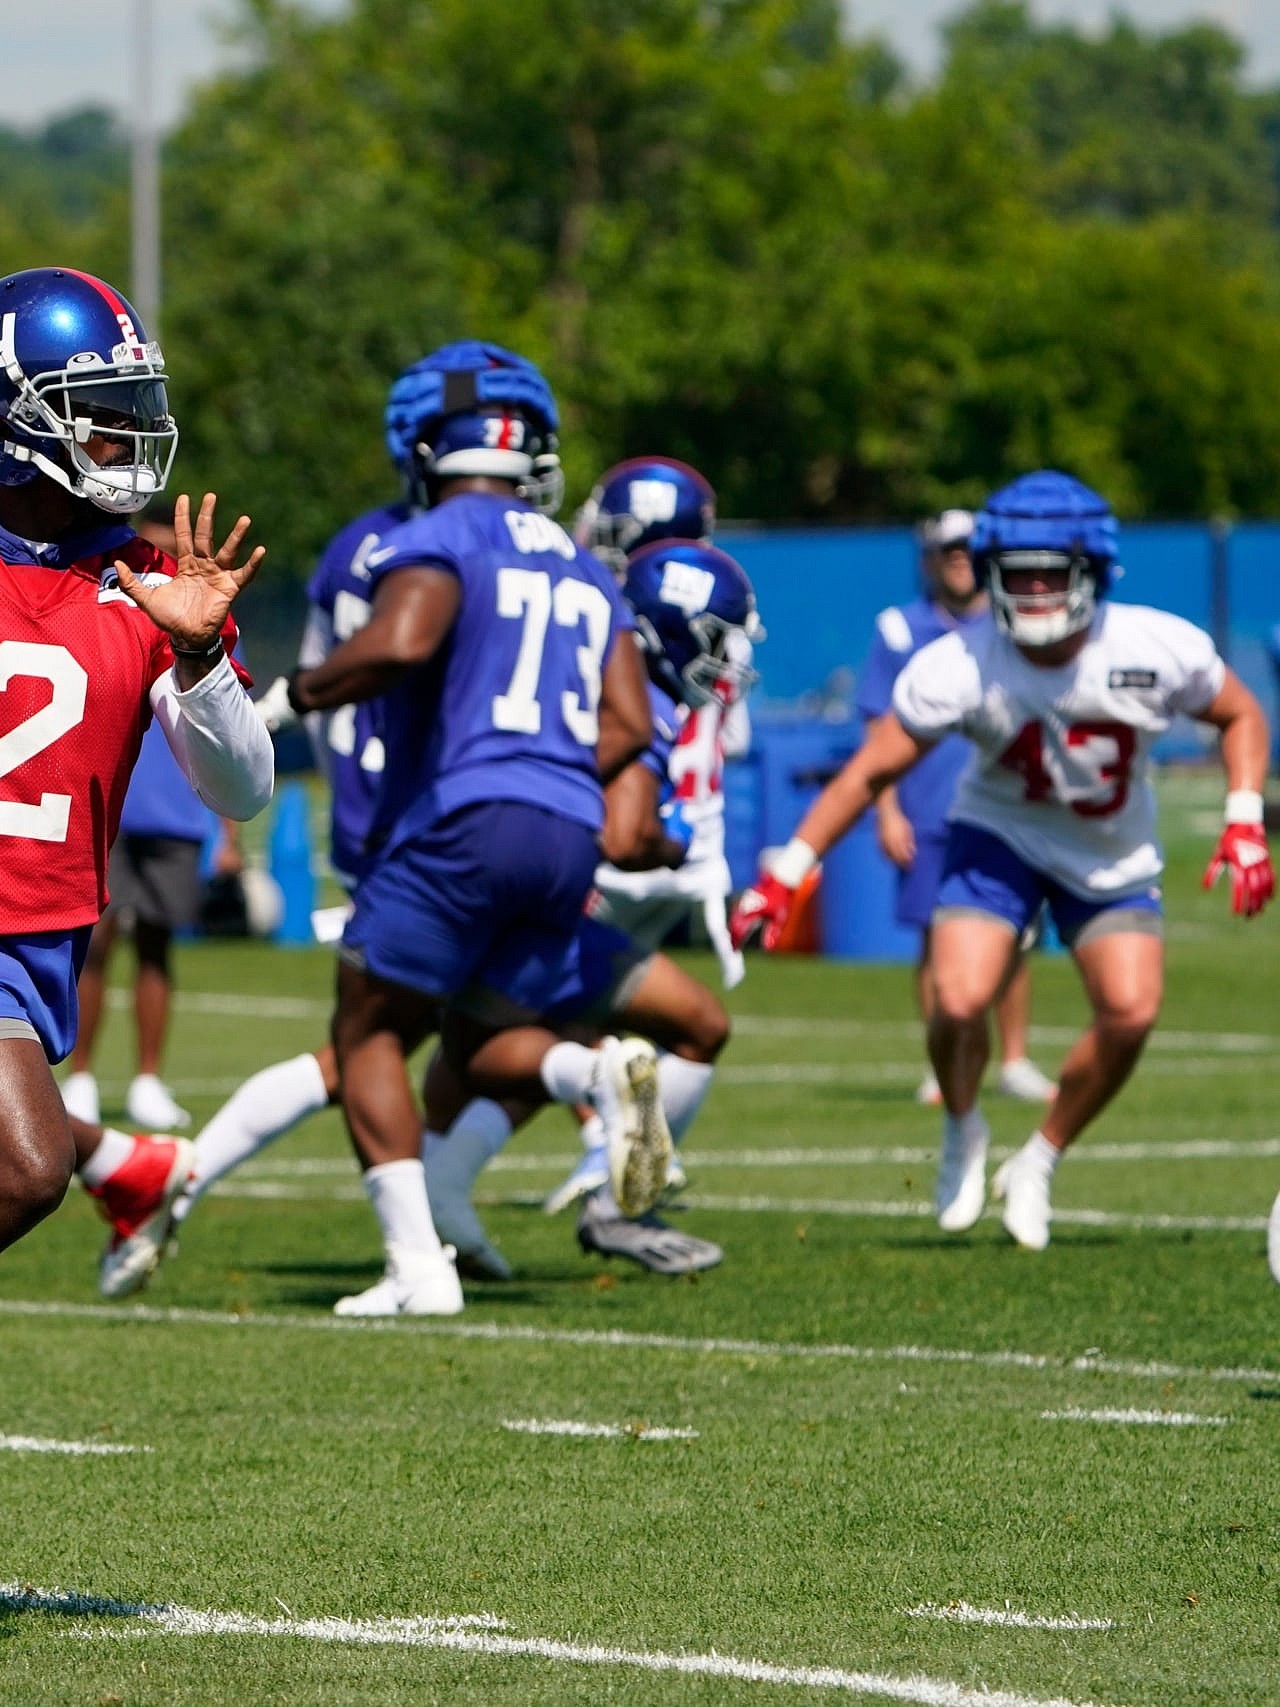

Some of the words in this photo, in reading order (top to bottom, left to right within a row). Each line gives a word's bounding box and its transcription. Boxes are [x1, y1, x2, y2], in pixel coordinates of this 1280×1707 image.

[117, 314, 139, 346] 2
[492, 567, 611, 746] 73
[998, 718, 1136, 820] 43
